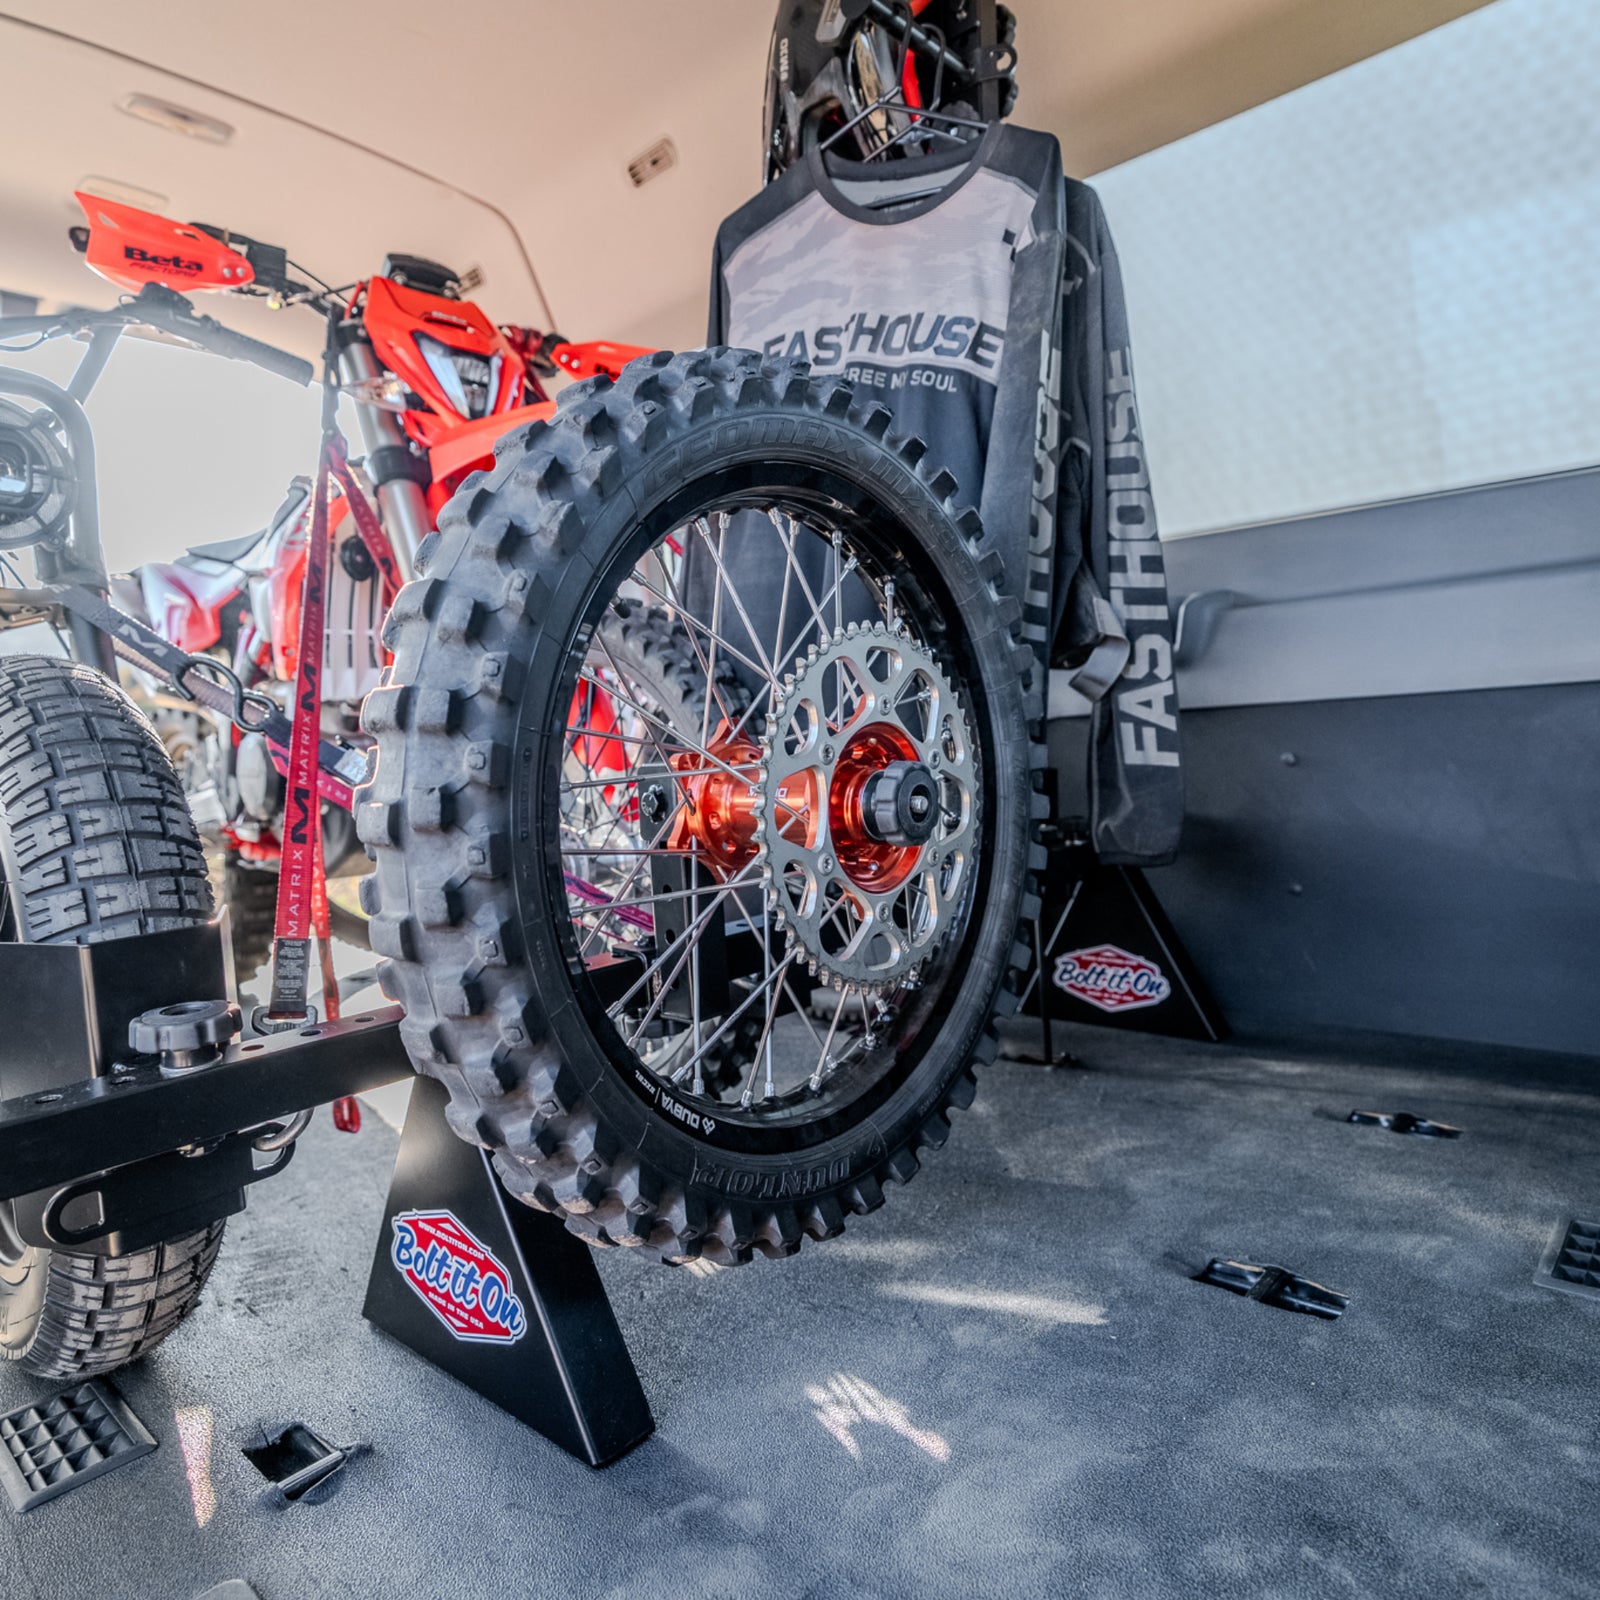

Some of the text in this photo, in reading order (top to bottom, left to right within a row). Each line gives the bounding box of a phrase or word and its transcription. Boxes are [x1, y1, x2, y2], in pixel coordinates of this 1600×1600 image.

[125, 245, 203, 272] Beta
[129, 262, 198, 277] FACTORY
[910, 370, 957, 392] SOUL
[643, 416, 866, 491] GEOMAX
[286, 849, 304, 937] MATRIX
[298, 713, 312, 785] MATRIX
[306, 606, 318, 665] MATRIX
[1059, 961, 1163, 995] Bolt it On
[661, 1091, 700, 1130] DUBYA
[698, 1154, 850, 1199] DUNLOP
[395, 1224, 522, 1332] Bolt it On
[428, 1291, 484, 1330] MADE IN THE USA
